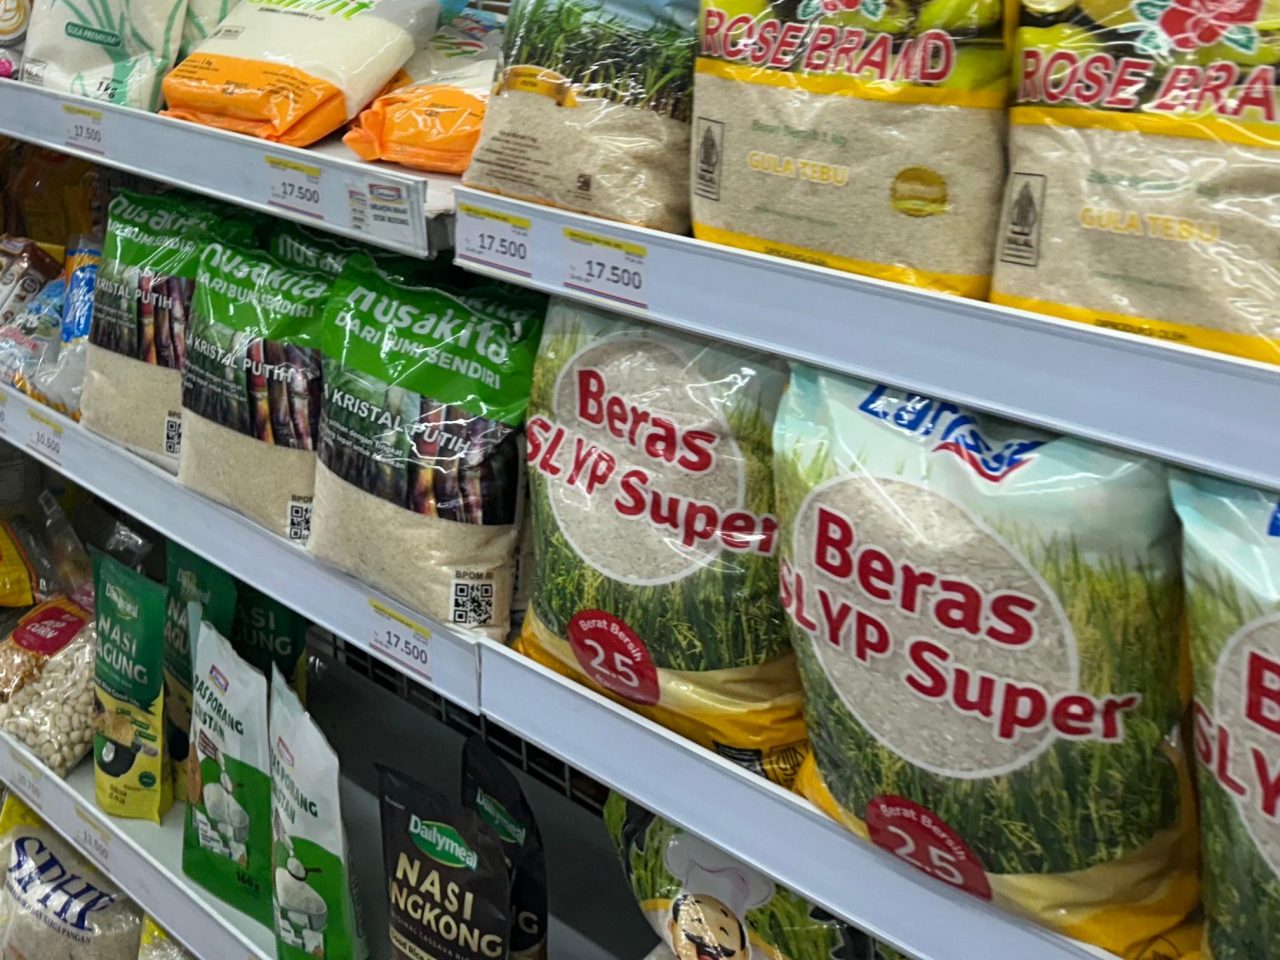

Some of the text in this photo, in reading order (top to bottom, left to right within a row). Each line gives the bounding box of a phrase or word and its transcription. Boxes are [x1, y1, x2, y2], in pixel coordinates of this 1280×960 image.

[700, 9, 957, 85] ROSE BRAND
[1016, 47, 1155, 109] ROSE
[281, 181, 320, 205] 17.500
[747, 149, 849, 188] GULA TEBU
[477, 232, 528, 261] 17.500
[1078, 206, 1218, 244] GULA TEBU
[201, 242, 332, 298] nusakita
[585, 259, 643, 290] 17.500
[134, 288, 173, 309] PUTIH
[347, 286, 510, 367] nusakita
[194, 338, 238, 369] KRISTAL
[242, 358, 295, 383] PUTIH
[334, 310, 379, 345] DARI
[426, 348, 501, 390] SENDIRI
[330, 387, 473, 454] KRISTAL PUTIH
[576, 369, 718, 473] Beras
[526, 416, 779, 555] SLYP Super
[455, 570, 484, 581] BPOM
[814, 507, 1038, 647] Beras
[95, 634, 149, 685] AGUNG
[97, 613, 138, 659] NASI
[386, 630, 428, 665] 17.500
[578, 617, 643, 664] Berat Bersih
[780, 556, 1142, 741] SLYP Super
[206, 692, 245, 737] PORANG
[408, 813, 480, 873] Dailymeal
[878, 803, 968, 863] Berat Bersih
[395, 851, 475, 922] NASI
[391, 882, 504, 959] NGKONG
